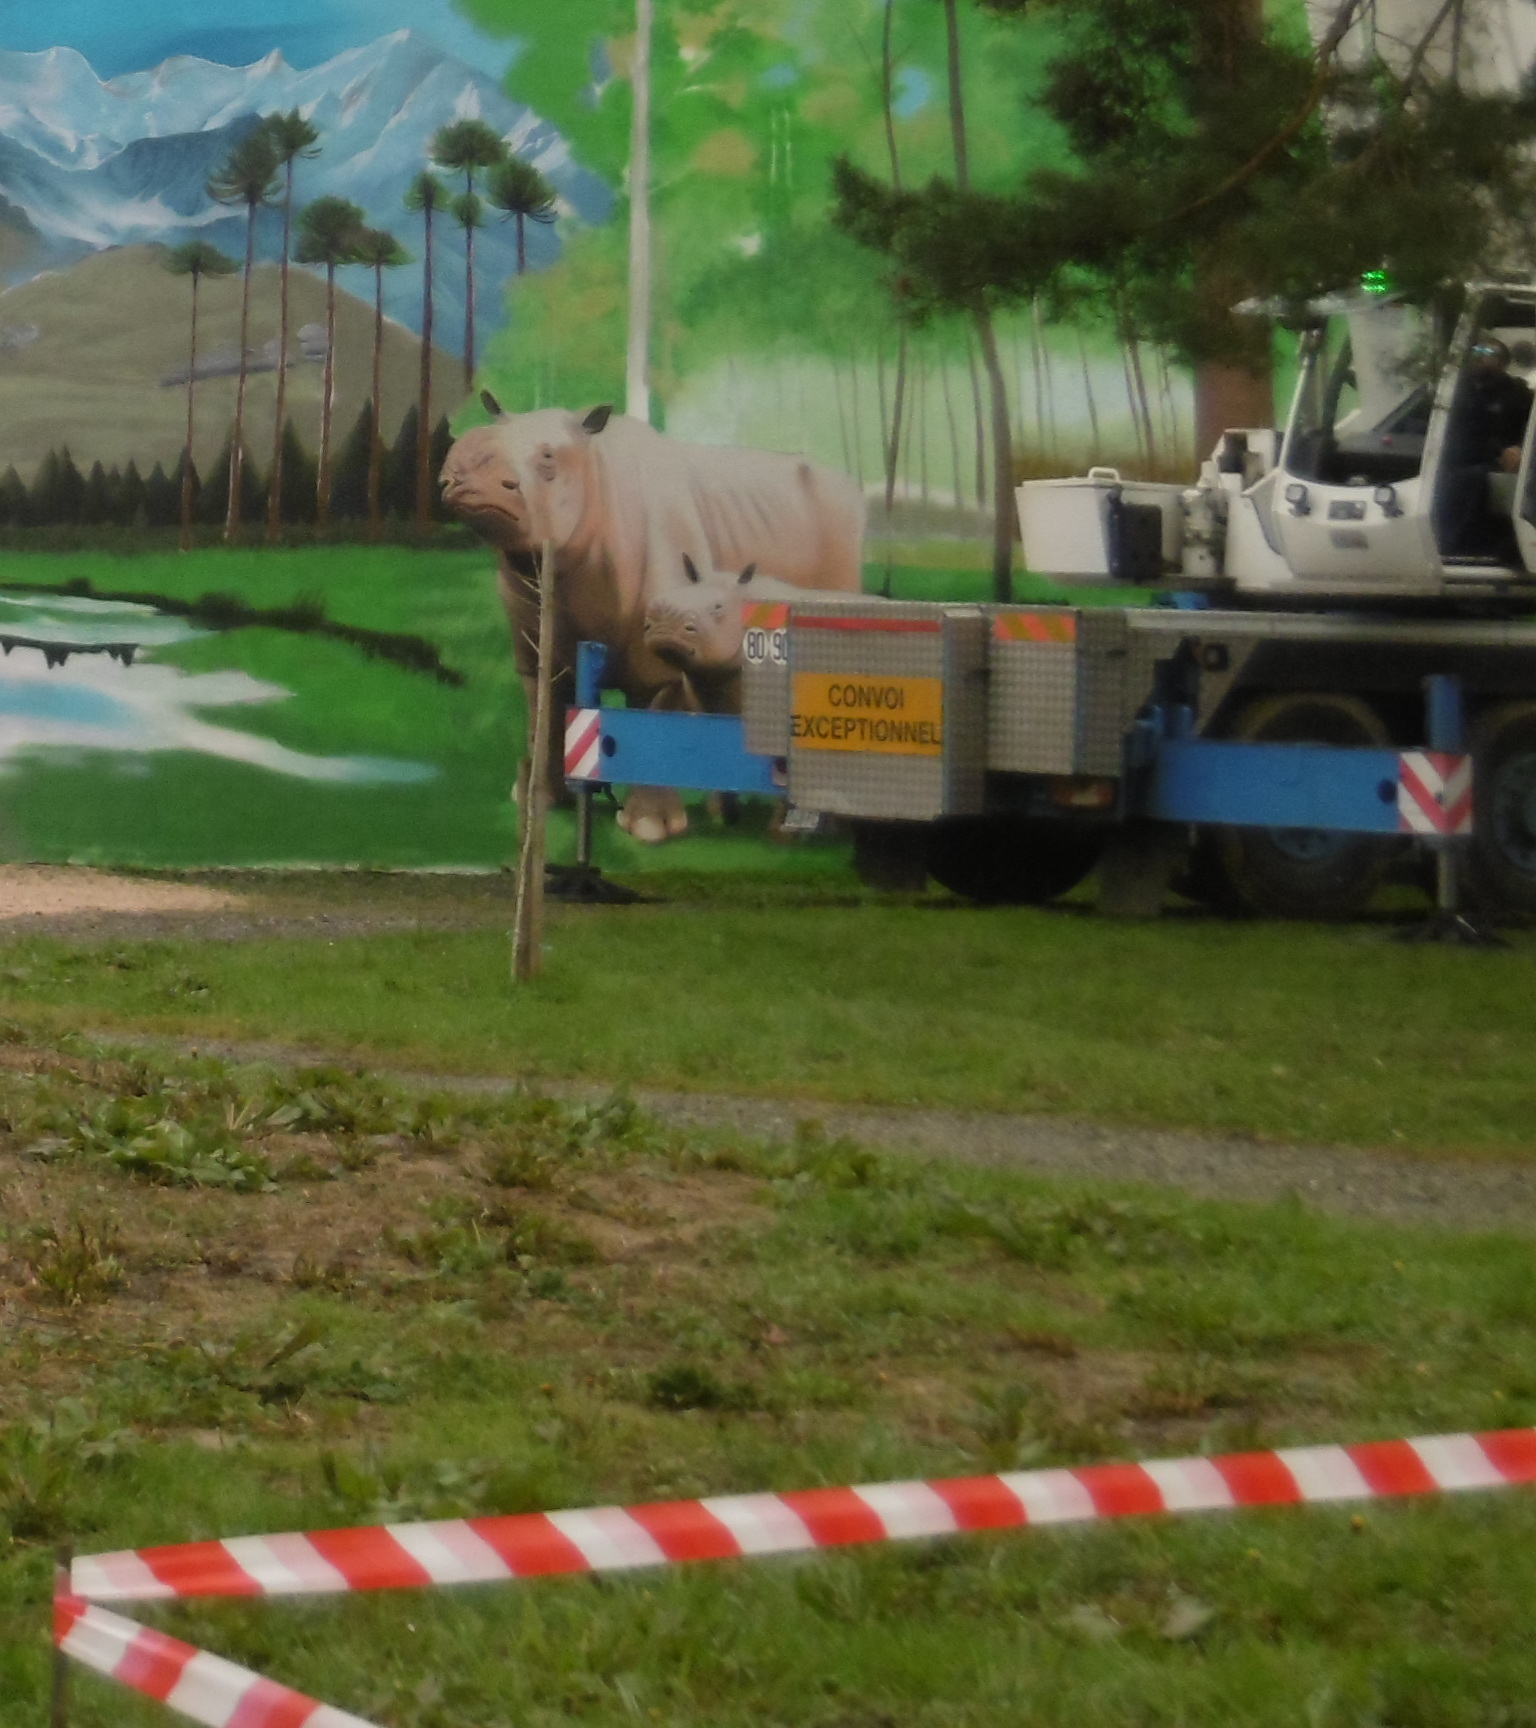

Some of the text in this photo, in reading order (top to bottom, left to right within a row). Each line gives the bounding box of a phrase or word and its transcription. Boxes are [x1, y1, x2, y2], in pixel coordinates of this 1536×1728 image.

[748, 631, 764, 659] 80
[828, 683, 905, 710] CONVOI
[790, 714, 941, 745] EXCEPTIONNEL
